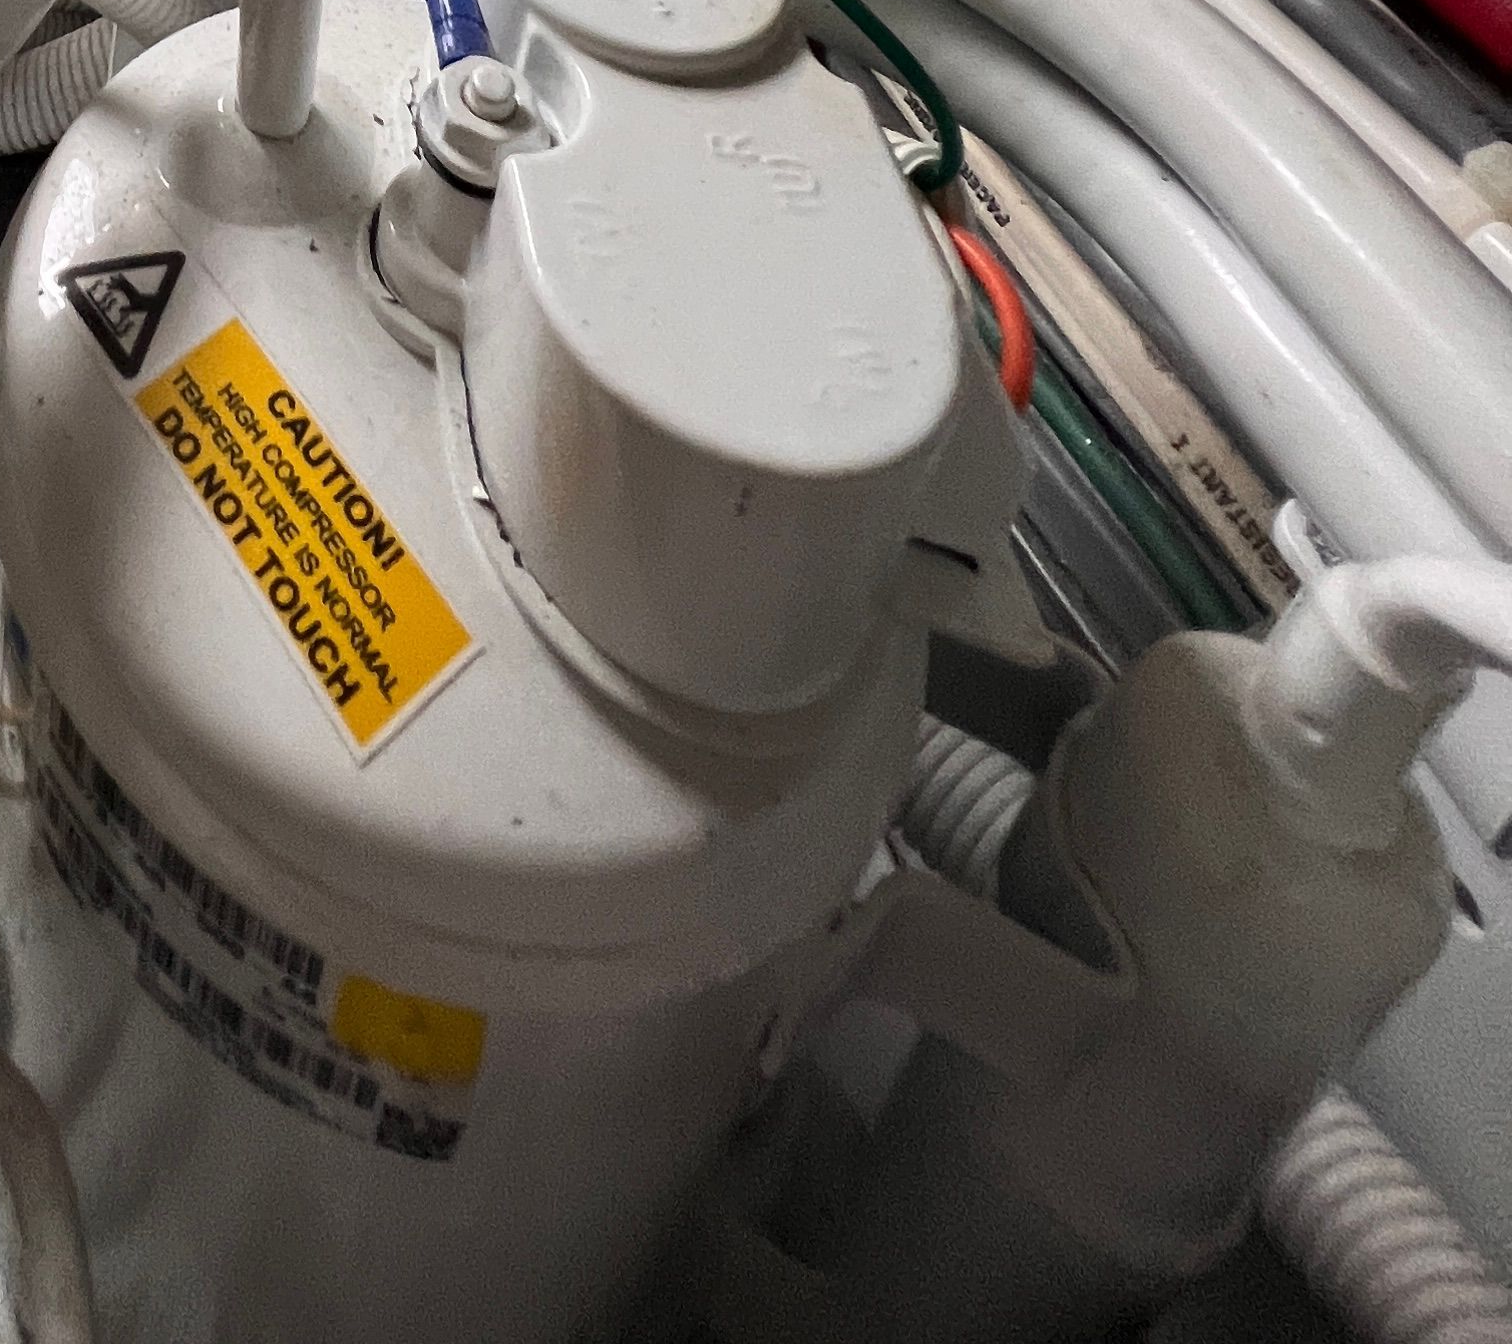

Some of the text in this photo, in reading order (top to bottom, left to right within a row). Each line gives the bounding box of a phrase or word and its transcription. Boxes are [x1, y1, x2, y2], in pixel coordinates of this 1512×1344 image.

[156, 407, 360, 707] DO NOT TOUCH
[172, 368, 399, 705] TEMPERATURE IS NORMAL
[218, 383, 397, 632] HIGH COMPRESSOR
